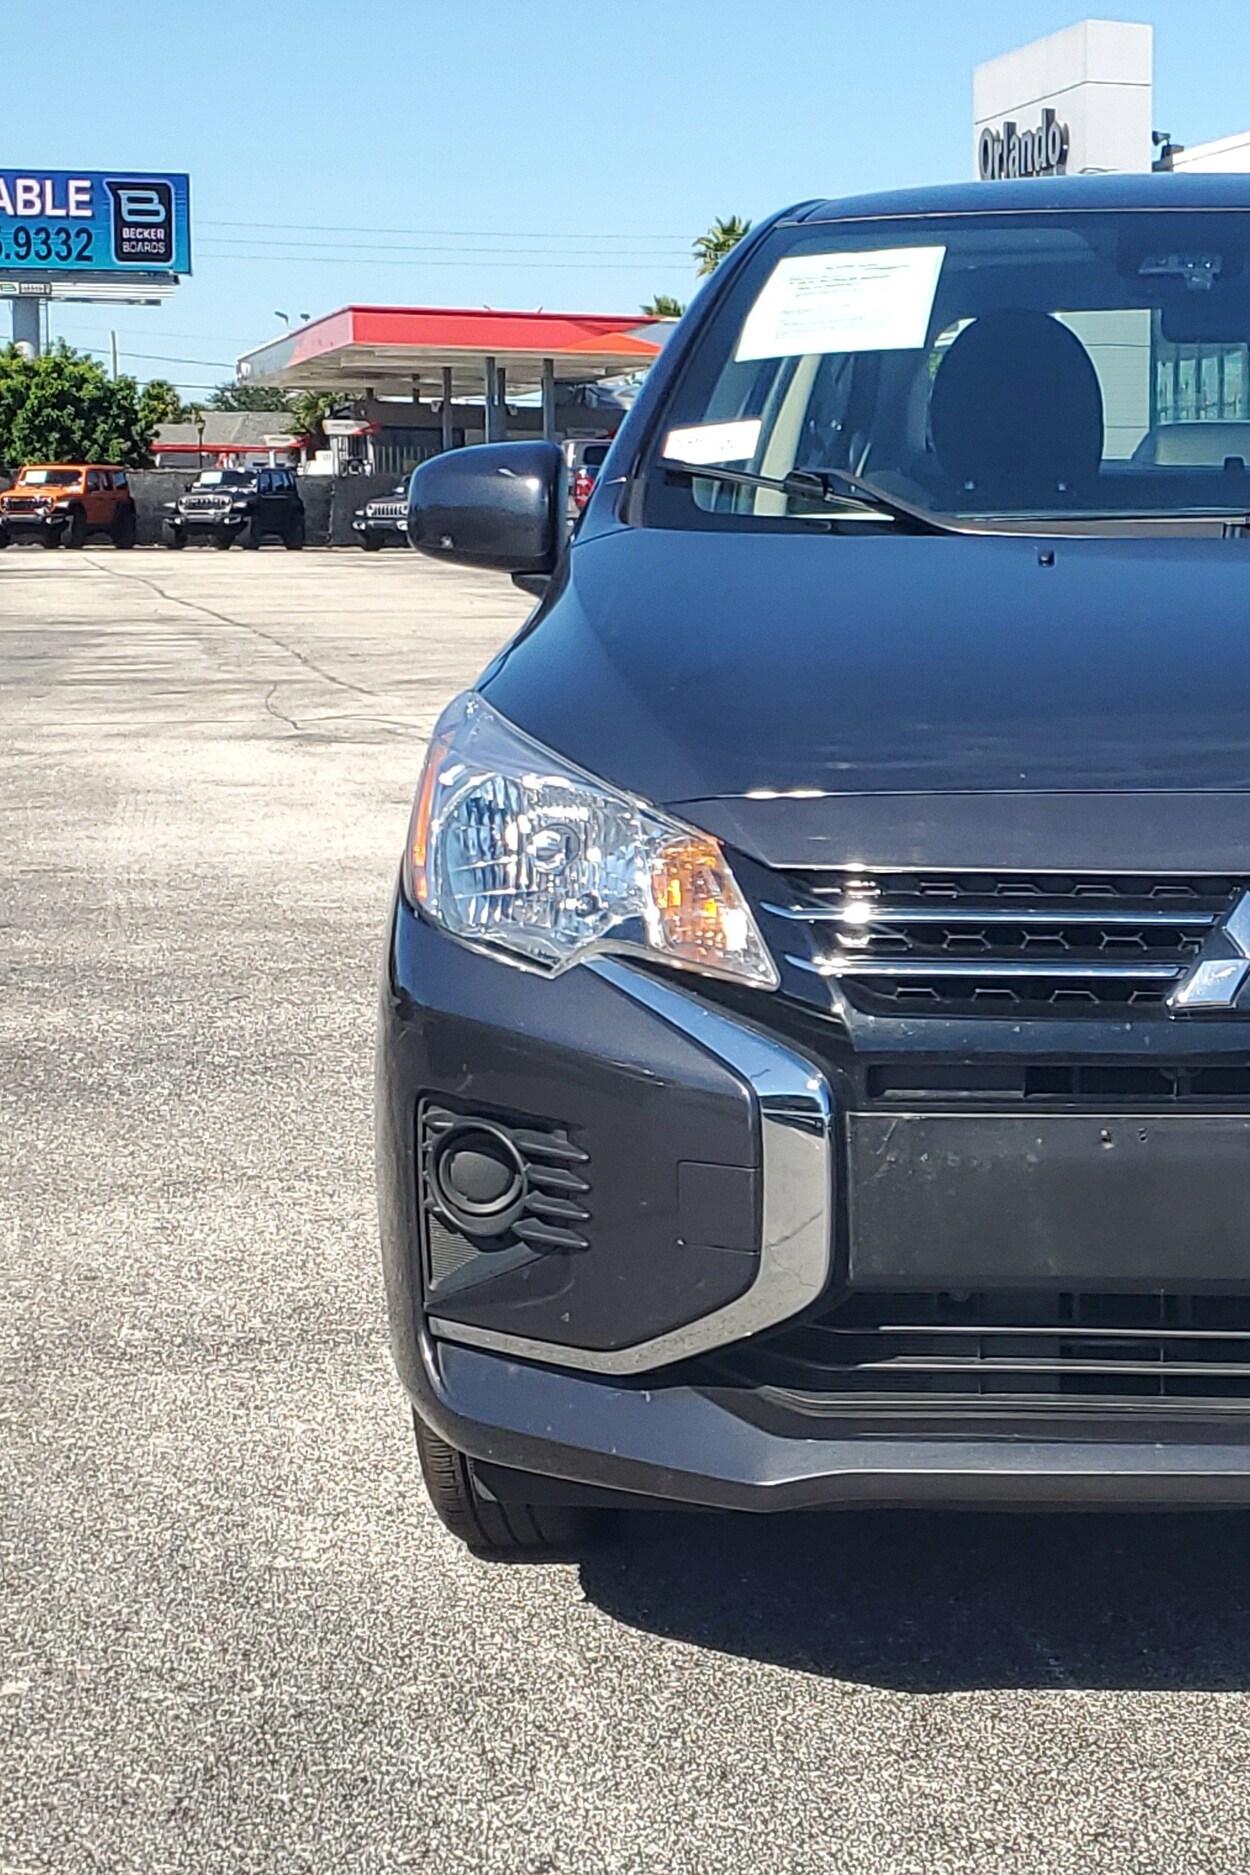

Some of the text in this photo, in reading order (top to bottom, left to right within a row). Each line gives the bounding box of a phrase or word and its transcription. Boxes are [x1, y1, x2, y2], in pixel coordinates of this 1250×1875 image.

[979, 108, 1069, 180] Orlando
[0, 226, 94, 262] .9332
[122, 227, 165, 240] BECKER
[122, 241, 166, 253] BOARDS
